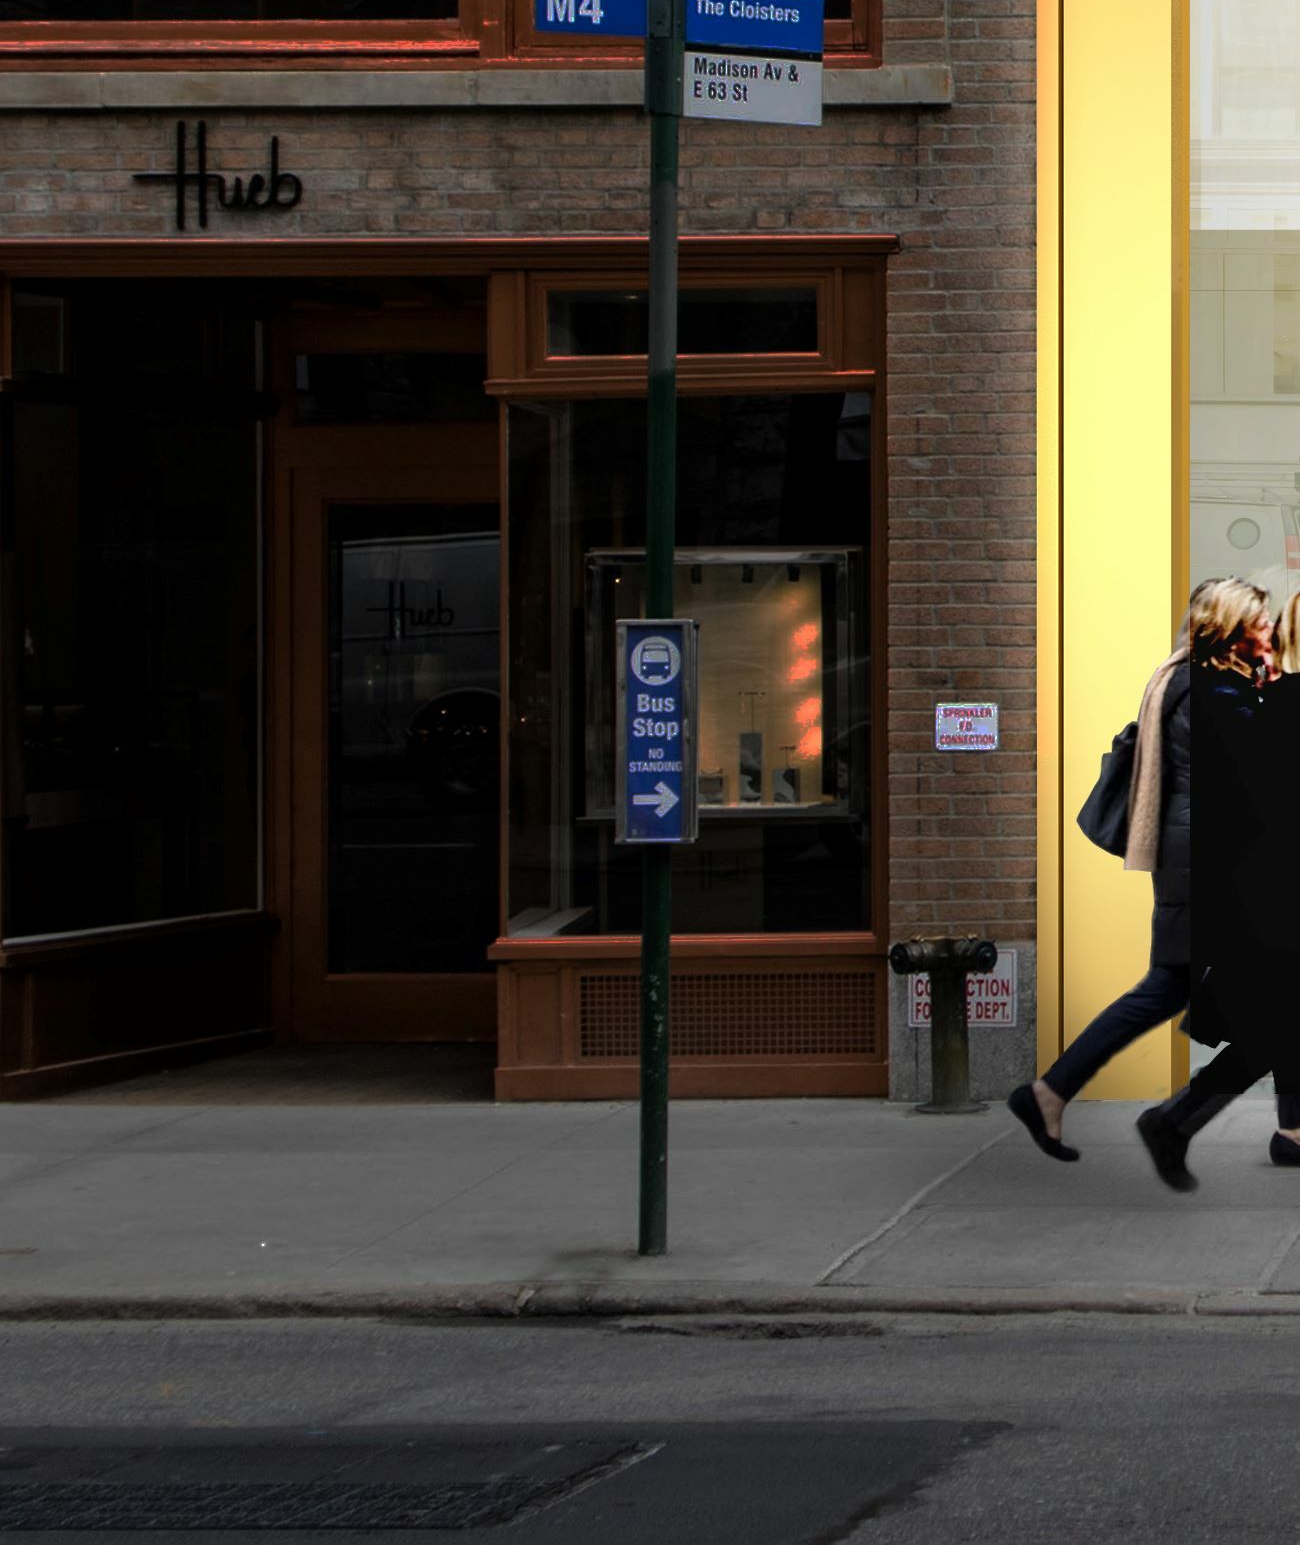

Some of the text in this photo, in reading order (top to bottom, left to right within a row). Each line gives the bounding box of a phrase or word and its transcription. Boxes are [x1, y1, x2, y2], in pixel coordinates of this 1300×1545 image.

[729, 0, 800, 24] Cloisters
[693, 57, 800, 83] Madison Av &
[693, 80, 749, 102] E 63 St
[132, 120, 304, 232] Hueb
[365, 580, 456, 640] Hueb
[637, 694, 675, 713] Bus
[942, 707, 993, 719] SPRINKLER
[632, 718, 679, 740] Stop
[940, 735, 995, 746] CONNECTION
[647, 748, 664, 759] NO
[628, 760, 683, 773] STANDING
[914, 978, 1010, 997] COCTION
